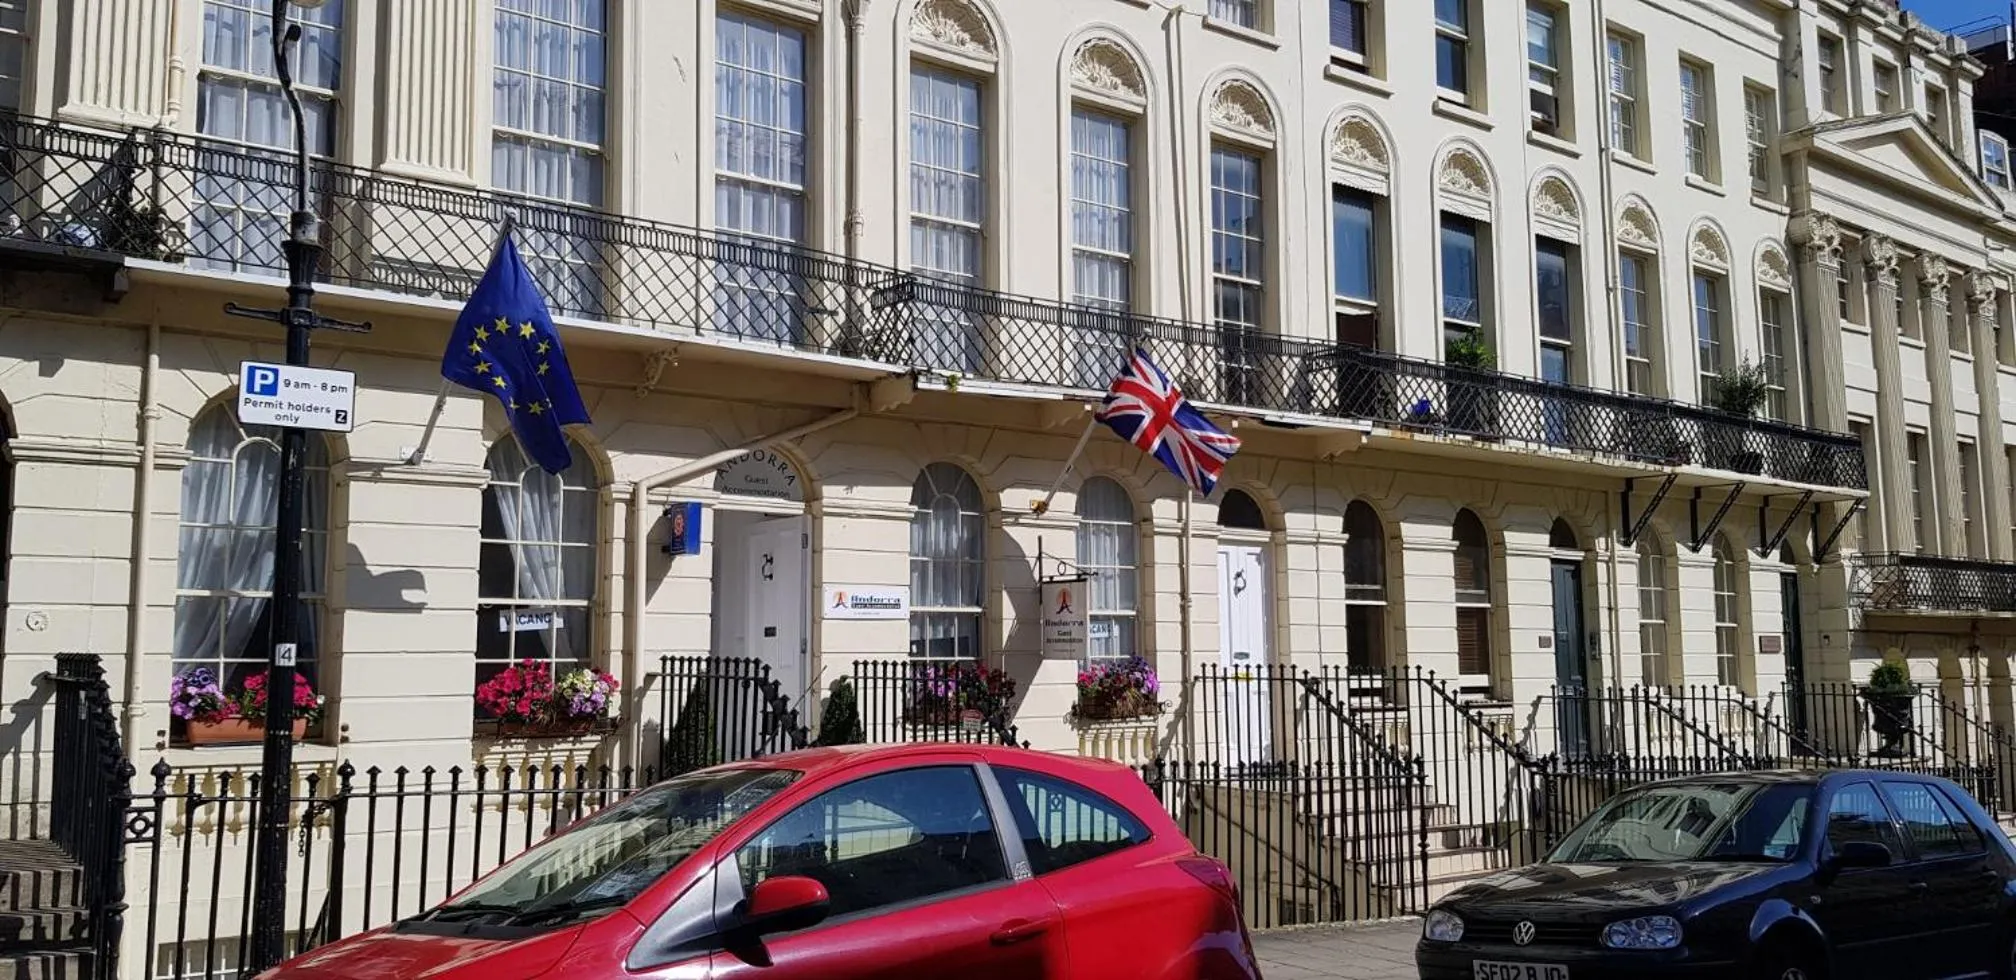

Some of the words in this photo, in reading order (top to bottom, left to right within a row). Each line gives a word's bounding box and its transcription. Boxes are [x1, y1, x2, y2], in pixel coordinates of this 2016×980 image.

[253, 369, 275, 393] P
[283, 379, 291, 387] 9
[293, 381, 311, 390] am
[321, 382, 328, 391] 8
[330, 384, 348, 393] pm
[244, 397, 284, 410] Permit
[287, 402, 331, 414] holders
[274, 413, 300, 424] only
[715, 449, 796, 487] ANDORRA
[851, 594, 901, 603] Andorra
